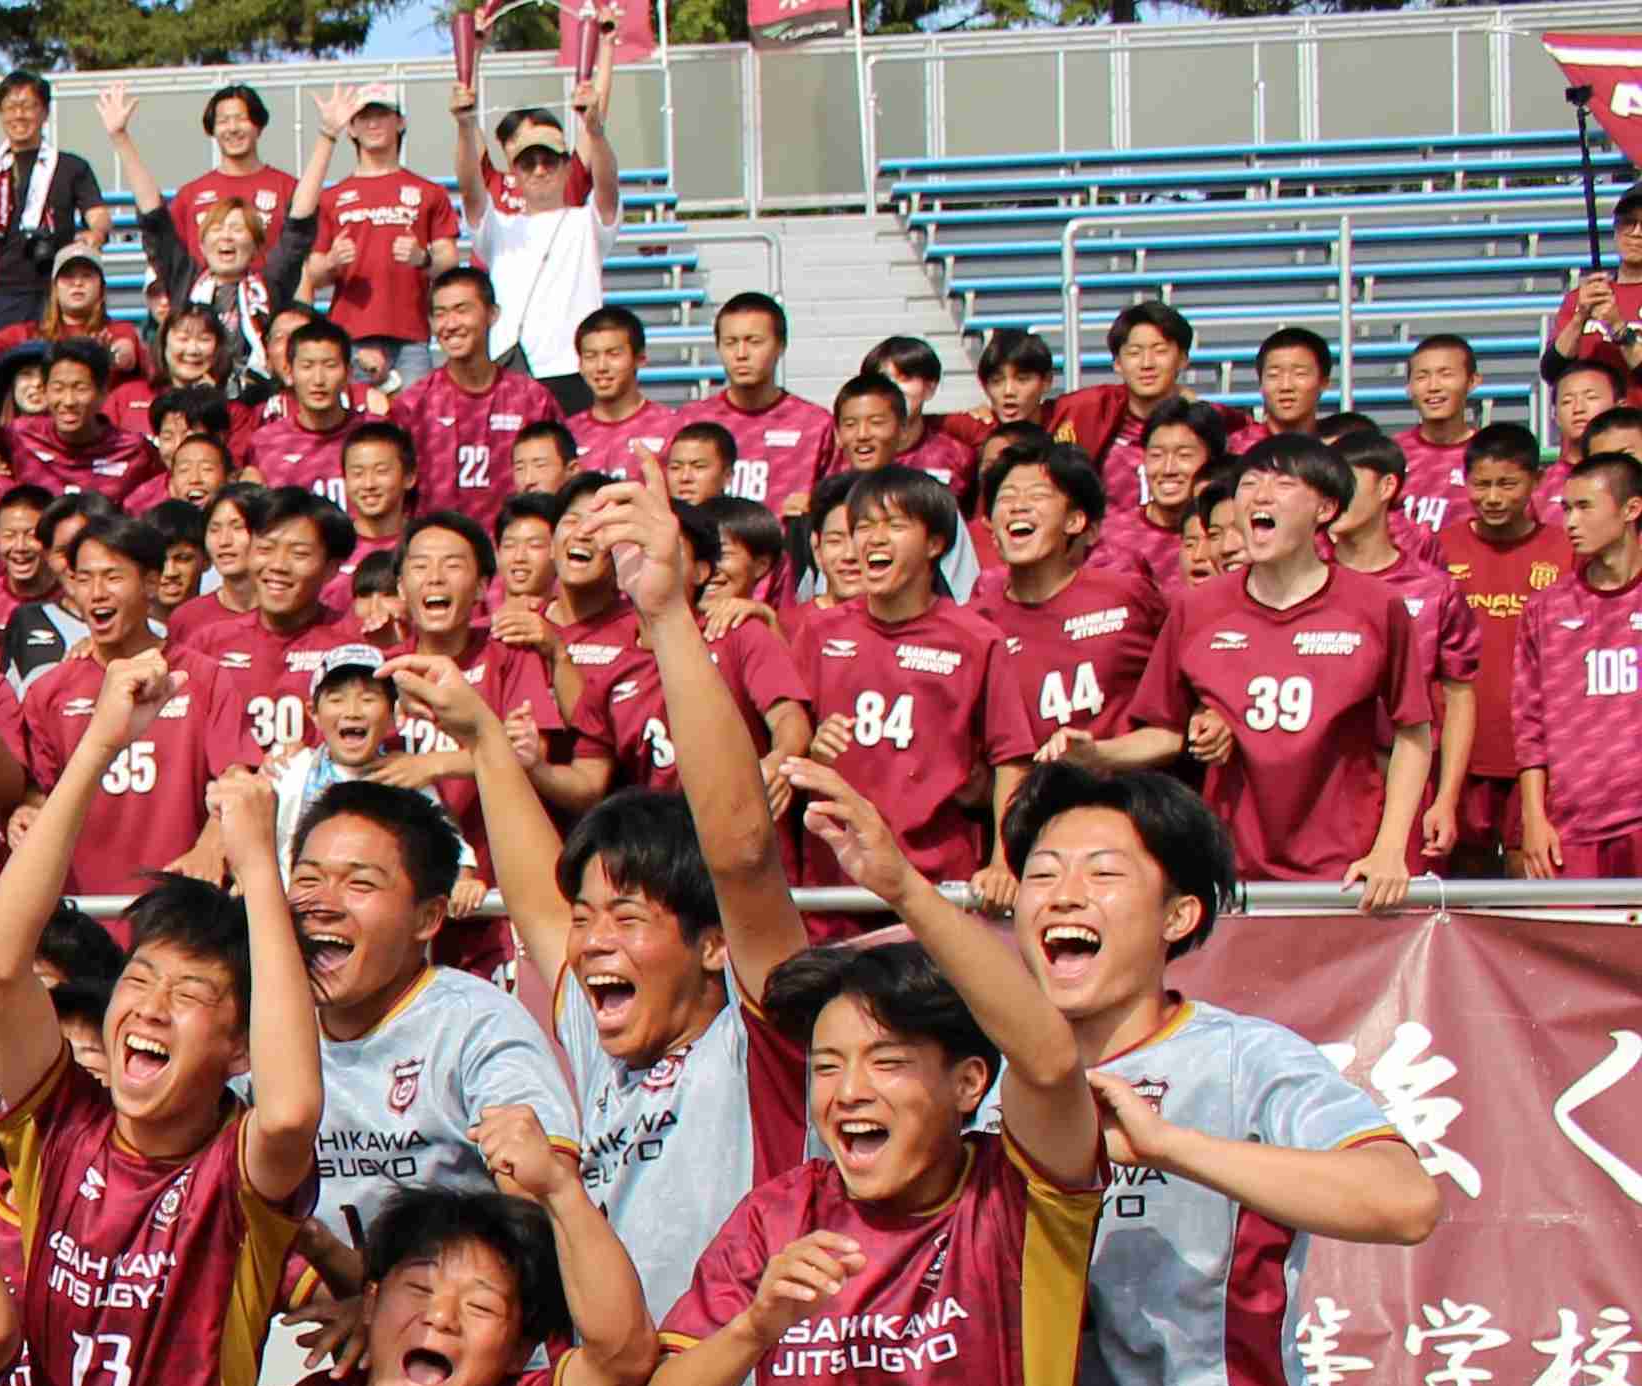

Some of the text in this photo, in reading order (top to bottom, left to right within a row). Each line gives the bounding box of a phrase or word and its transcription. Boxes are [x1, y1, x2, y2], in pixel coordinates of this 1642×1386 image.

[458, 448, 491, 488] 22
[1037, 662, 1106, 725] 44
[1583, 647, 1639, 697] 106
[247, 695, 304, 748] 30
[854, 690, 914, 749] 84
[1246, 675, 1314, 738] 39
[101, 740, 157, 796] 35
[318, 1131, 428, 1153] HIKAWA
[318, 1157, 417, 1178] SUGYO
[778, 1296, 966, 1346] SAHIKAWA
